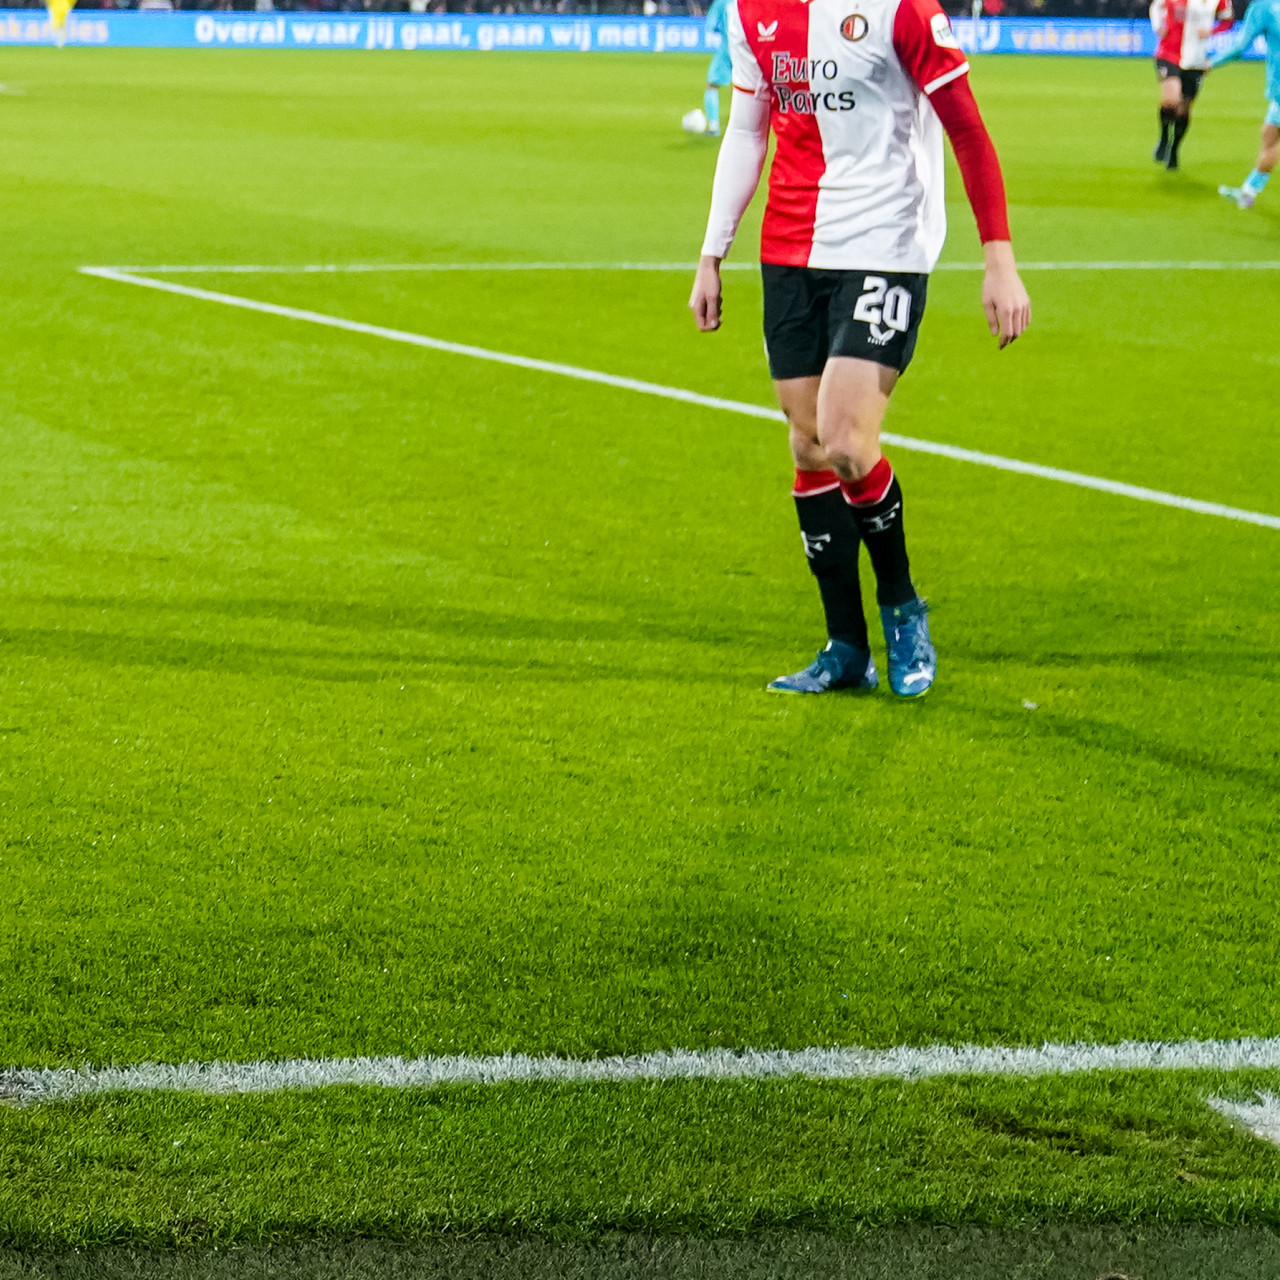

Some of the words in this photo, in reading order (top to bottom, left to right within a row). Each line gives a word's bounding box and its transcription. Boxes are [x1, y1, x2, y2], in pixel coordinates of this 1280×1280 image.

[195, 15, 286, 44] Overal
[291, 21, 362, 45] waar
[366, 18, 395, 51] jij
[400, 21, 472, 51] gaat,
[477, 23, 545, 51] gaan
[550, 19, 592, 52] wij
[597, 22, 651, 48] met
[654, 19, 700, 53] jou
[770, 51, 839, 84] Euro
[773, 84, 857, 115] Parcs
[852, 275, 913, 333] 20
